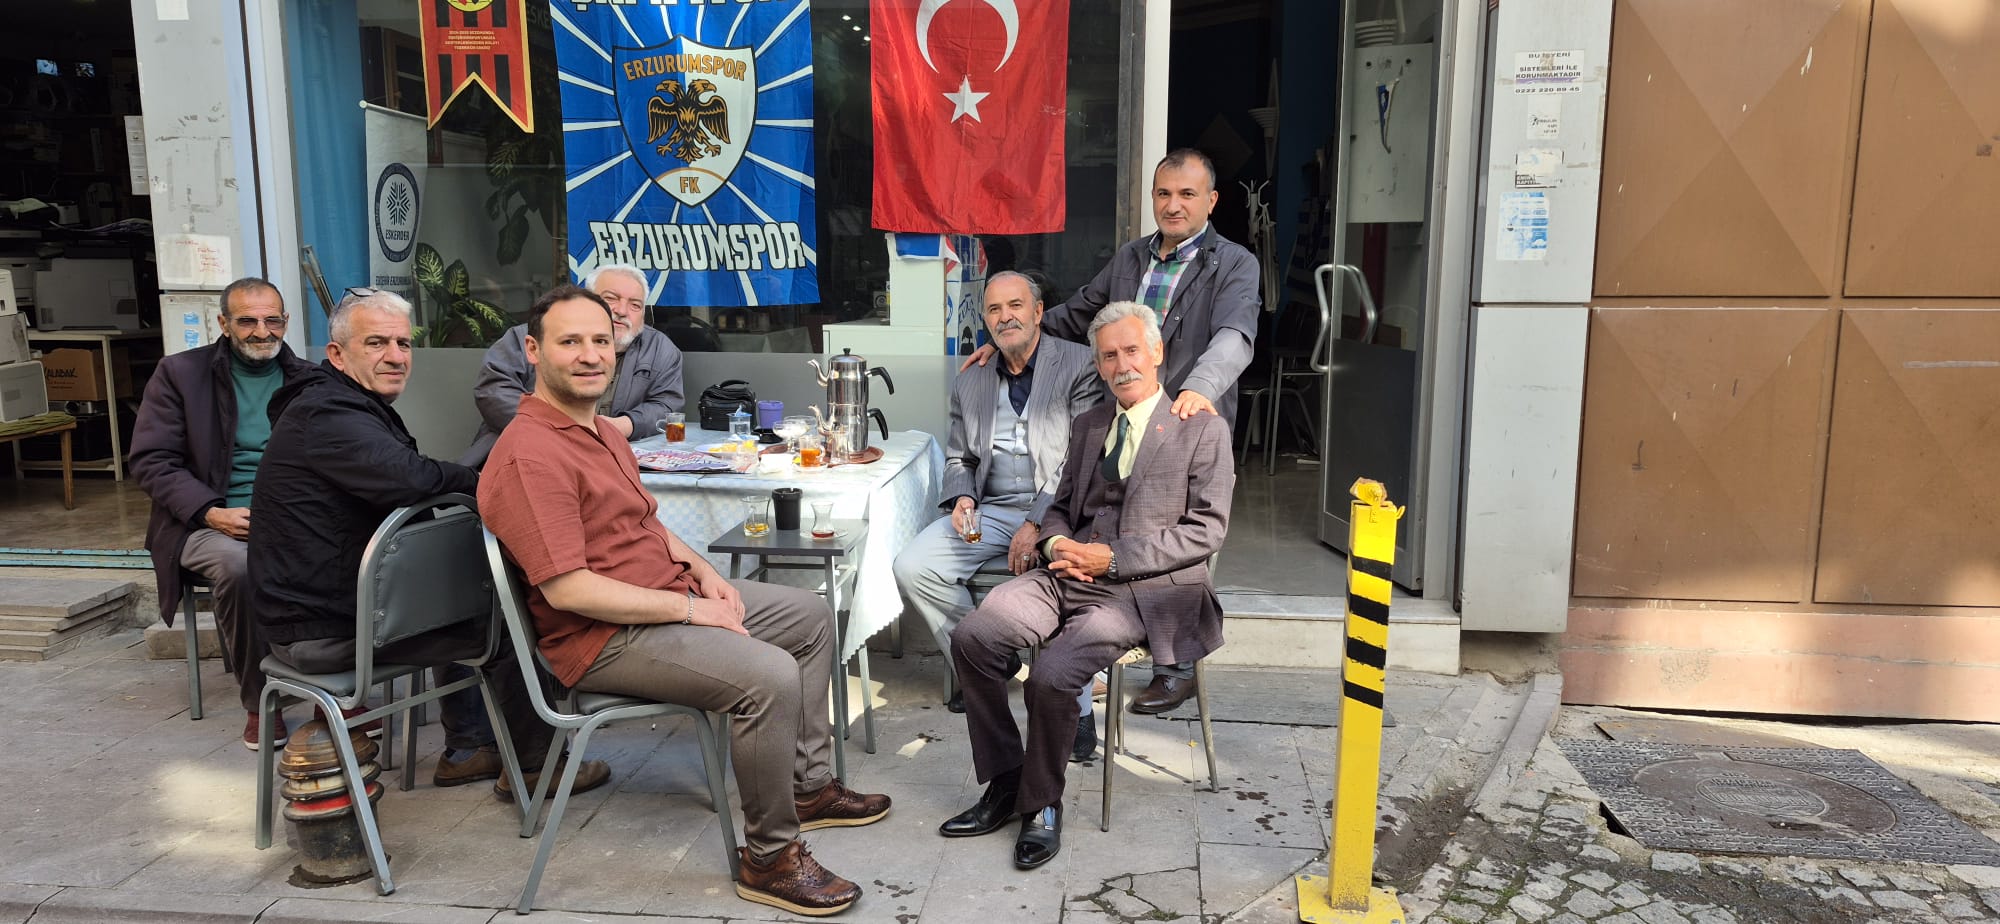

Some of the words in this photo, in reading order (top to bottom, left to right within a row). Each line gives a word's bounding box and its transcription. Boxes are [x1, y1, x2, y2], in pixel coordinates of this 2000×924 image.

[622, 53, 747, 82] ERZURUMSPOR
[1515, 71, 1581, 79] KORUNMAKTADIR
[679, 176, 701, 194] FK
[588, 220, 806, 271] ERZURUMSPOR
